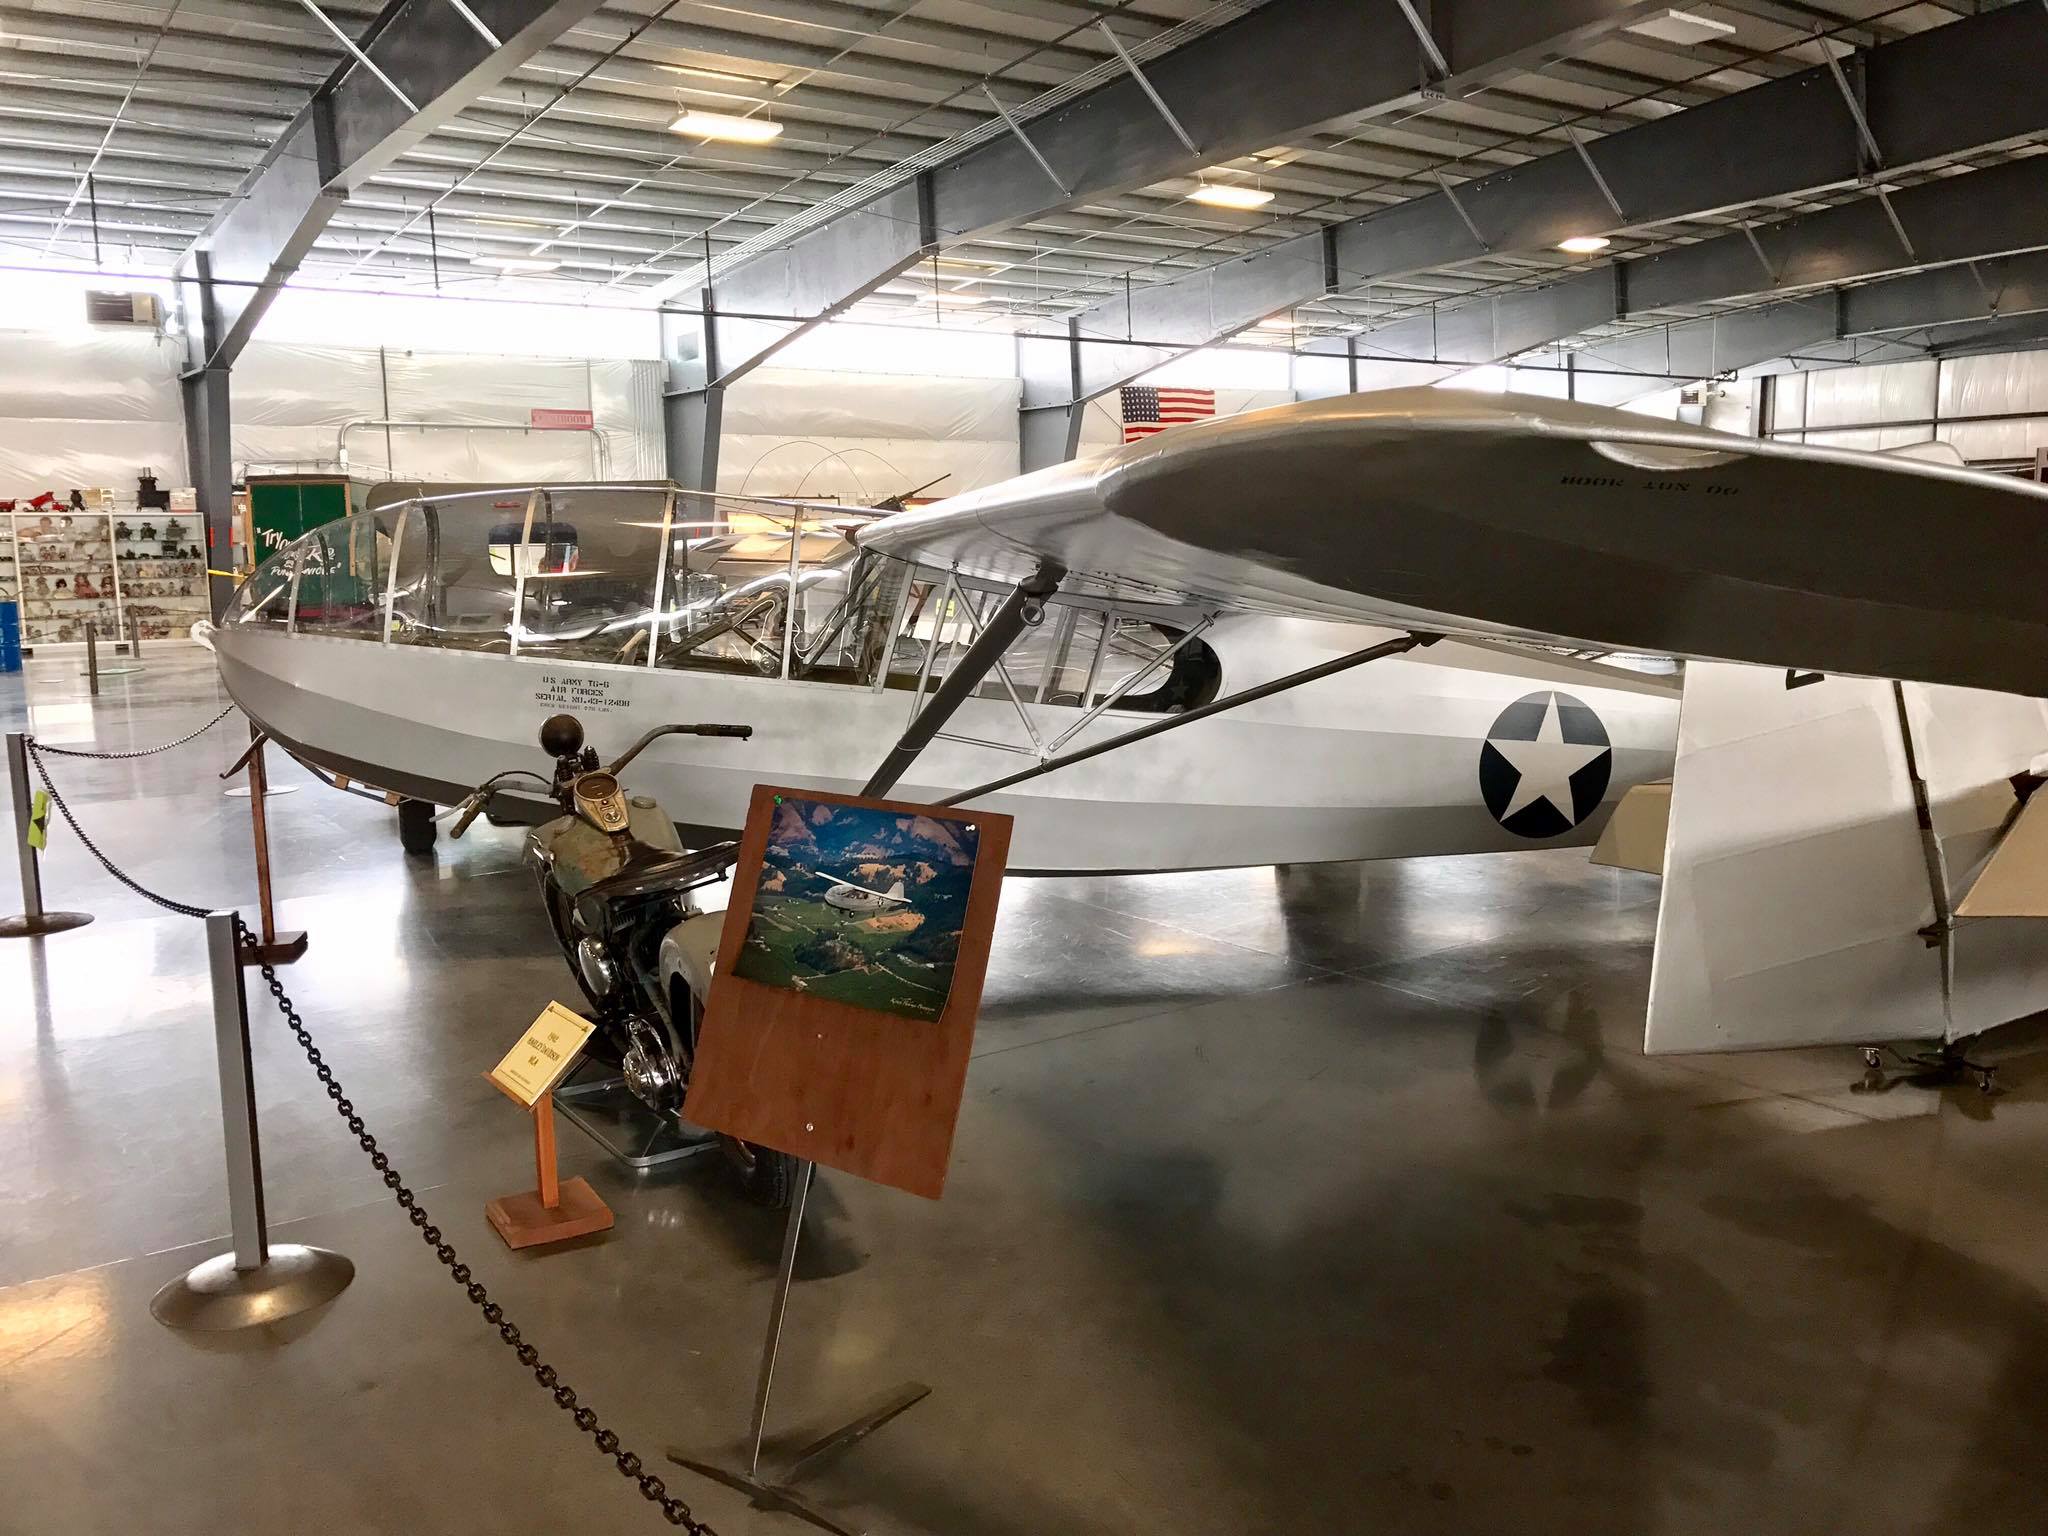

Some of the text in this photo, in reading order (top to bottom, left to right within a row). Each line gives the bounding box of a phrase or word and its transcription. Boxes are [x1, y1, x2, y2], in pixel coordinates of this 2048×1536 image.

[561, 678, 583, 686] ARMY
[588, 679, 610, 688] TG-6
[550, 685, 604, 697] AIR FORCES
[535, 692, 567, 702] SERIAL
